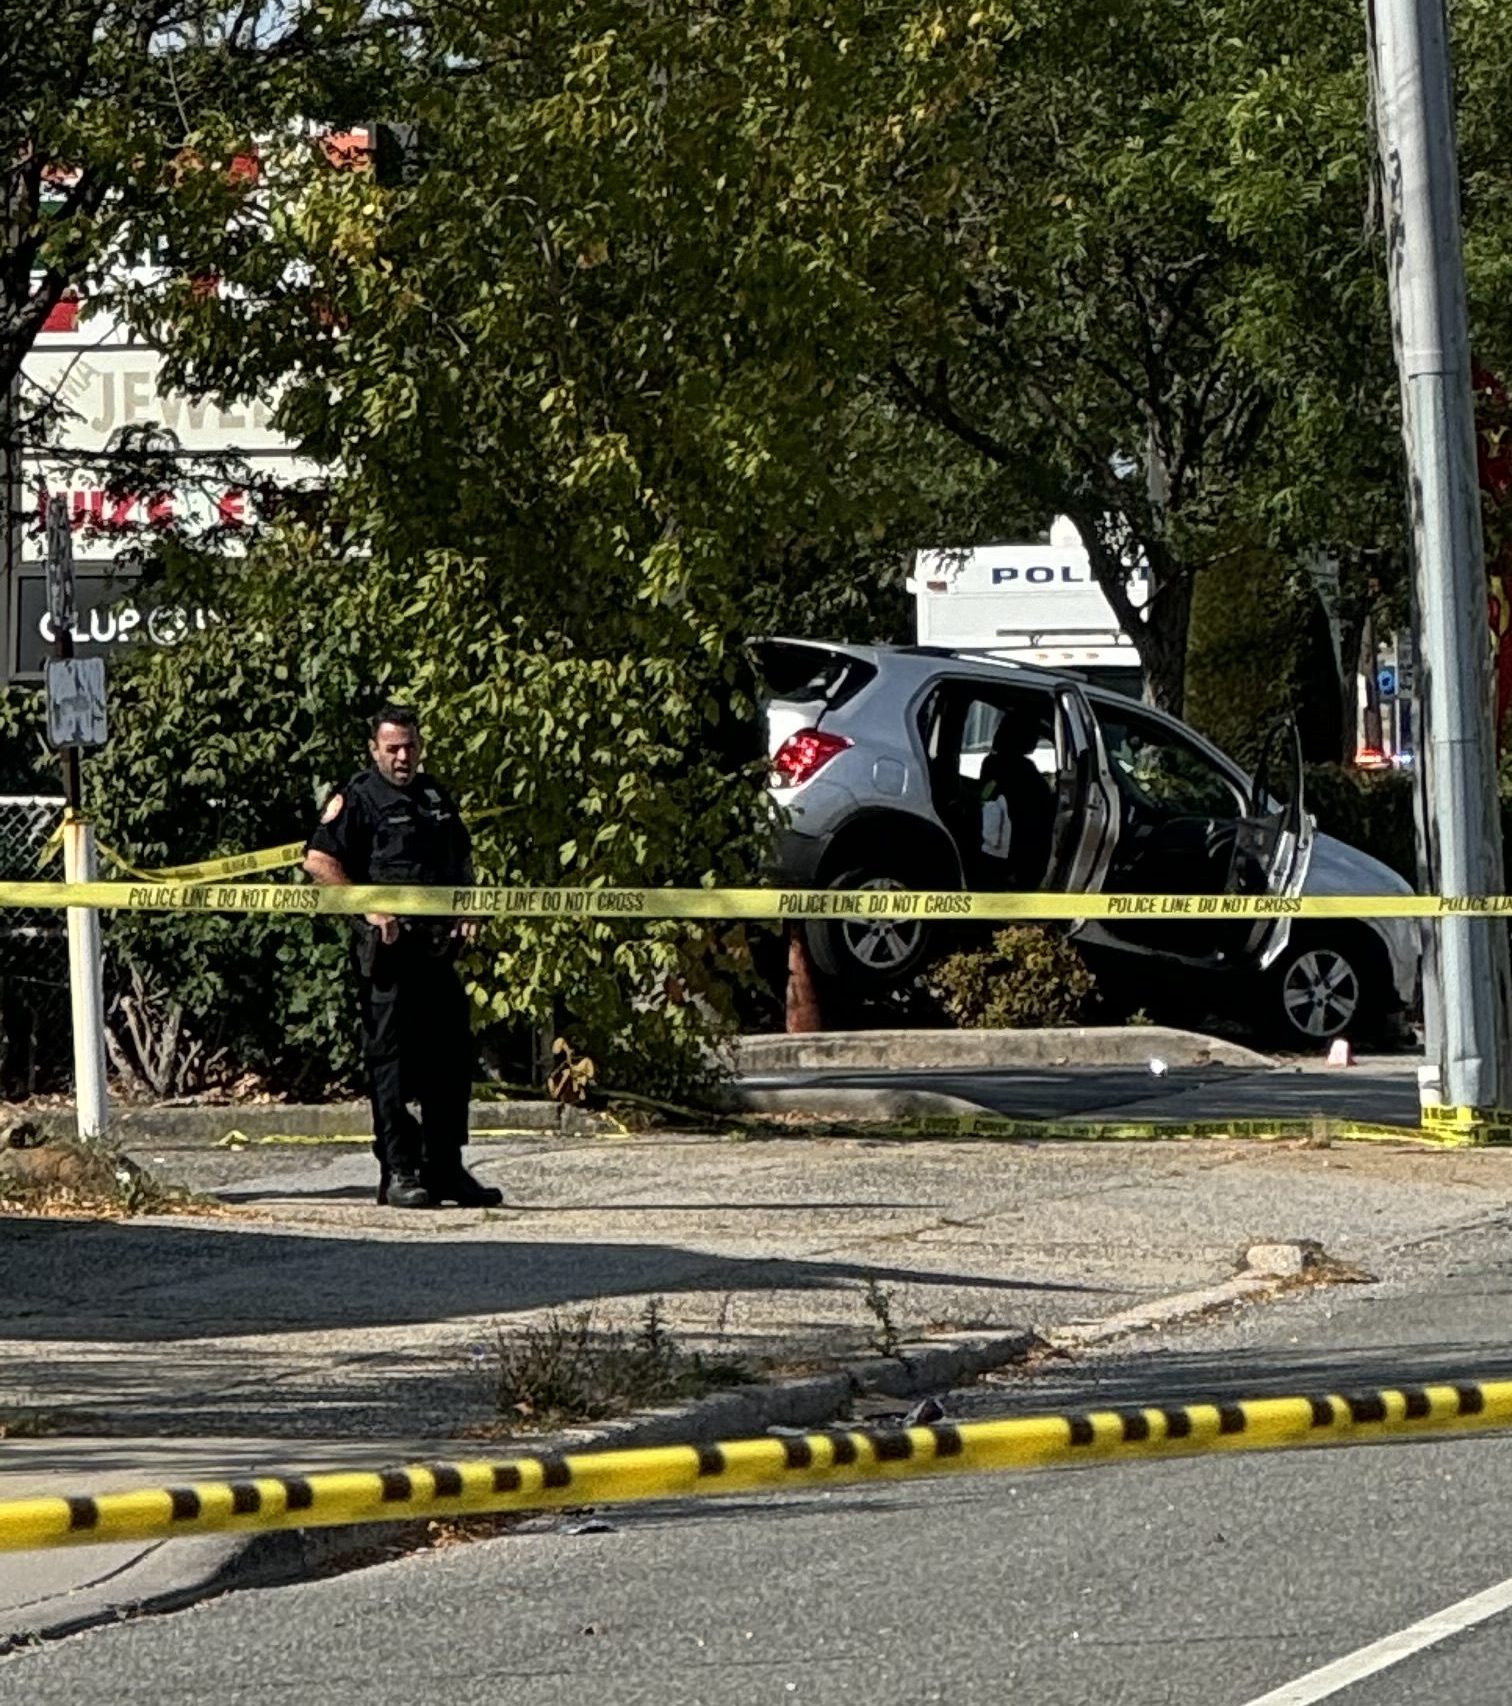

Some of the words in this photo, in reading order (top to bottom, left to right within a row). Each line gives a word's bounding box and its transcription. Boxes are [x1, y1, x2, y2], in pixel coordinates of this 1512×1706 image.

[992, 566, 1150, 584] POL
[128, 888, 179, 908] POLICE
[182, 888, 213, 908] LINE
[217, 888, 237, 908] DO
[240, 888, 269, 908] NOT
[272, 889, 320, 910] CROSS
[452, 890, 502, 911] POLICE
[506, 891, 536, 911] LINE
[541, 891, 561, 911] DO
[565, 891, 593, 911] NOT
[597, 892, 646, 911] CROSS
[778, 893, 831, 913] POLICE
[832, 893, 863, 913] LINE
[868, 894, 887, 913] DO
[891, 894, 921, 913] NOT
[924, 895, 972, 913] CROSS
[1108, 897, 1157, 914] POLICE
[1161, 897, 1194, 913] LINE
[1197, 897, 1217, 913] DO
[1220, 897, 1252, 913] NOT
[1253, 897, 1302, 913] CROSS
[1438, 896, 1488, 911] POLICE
